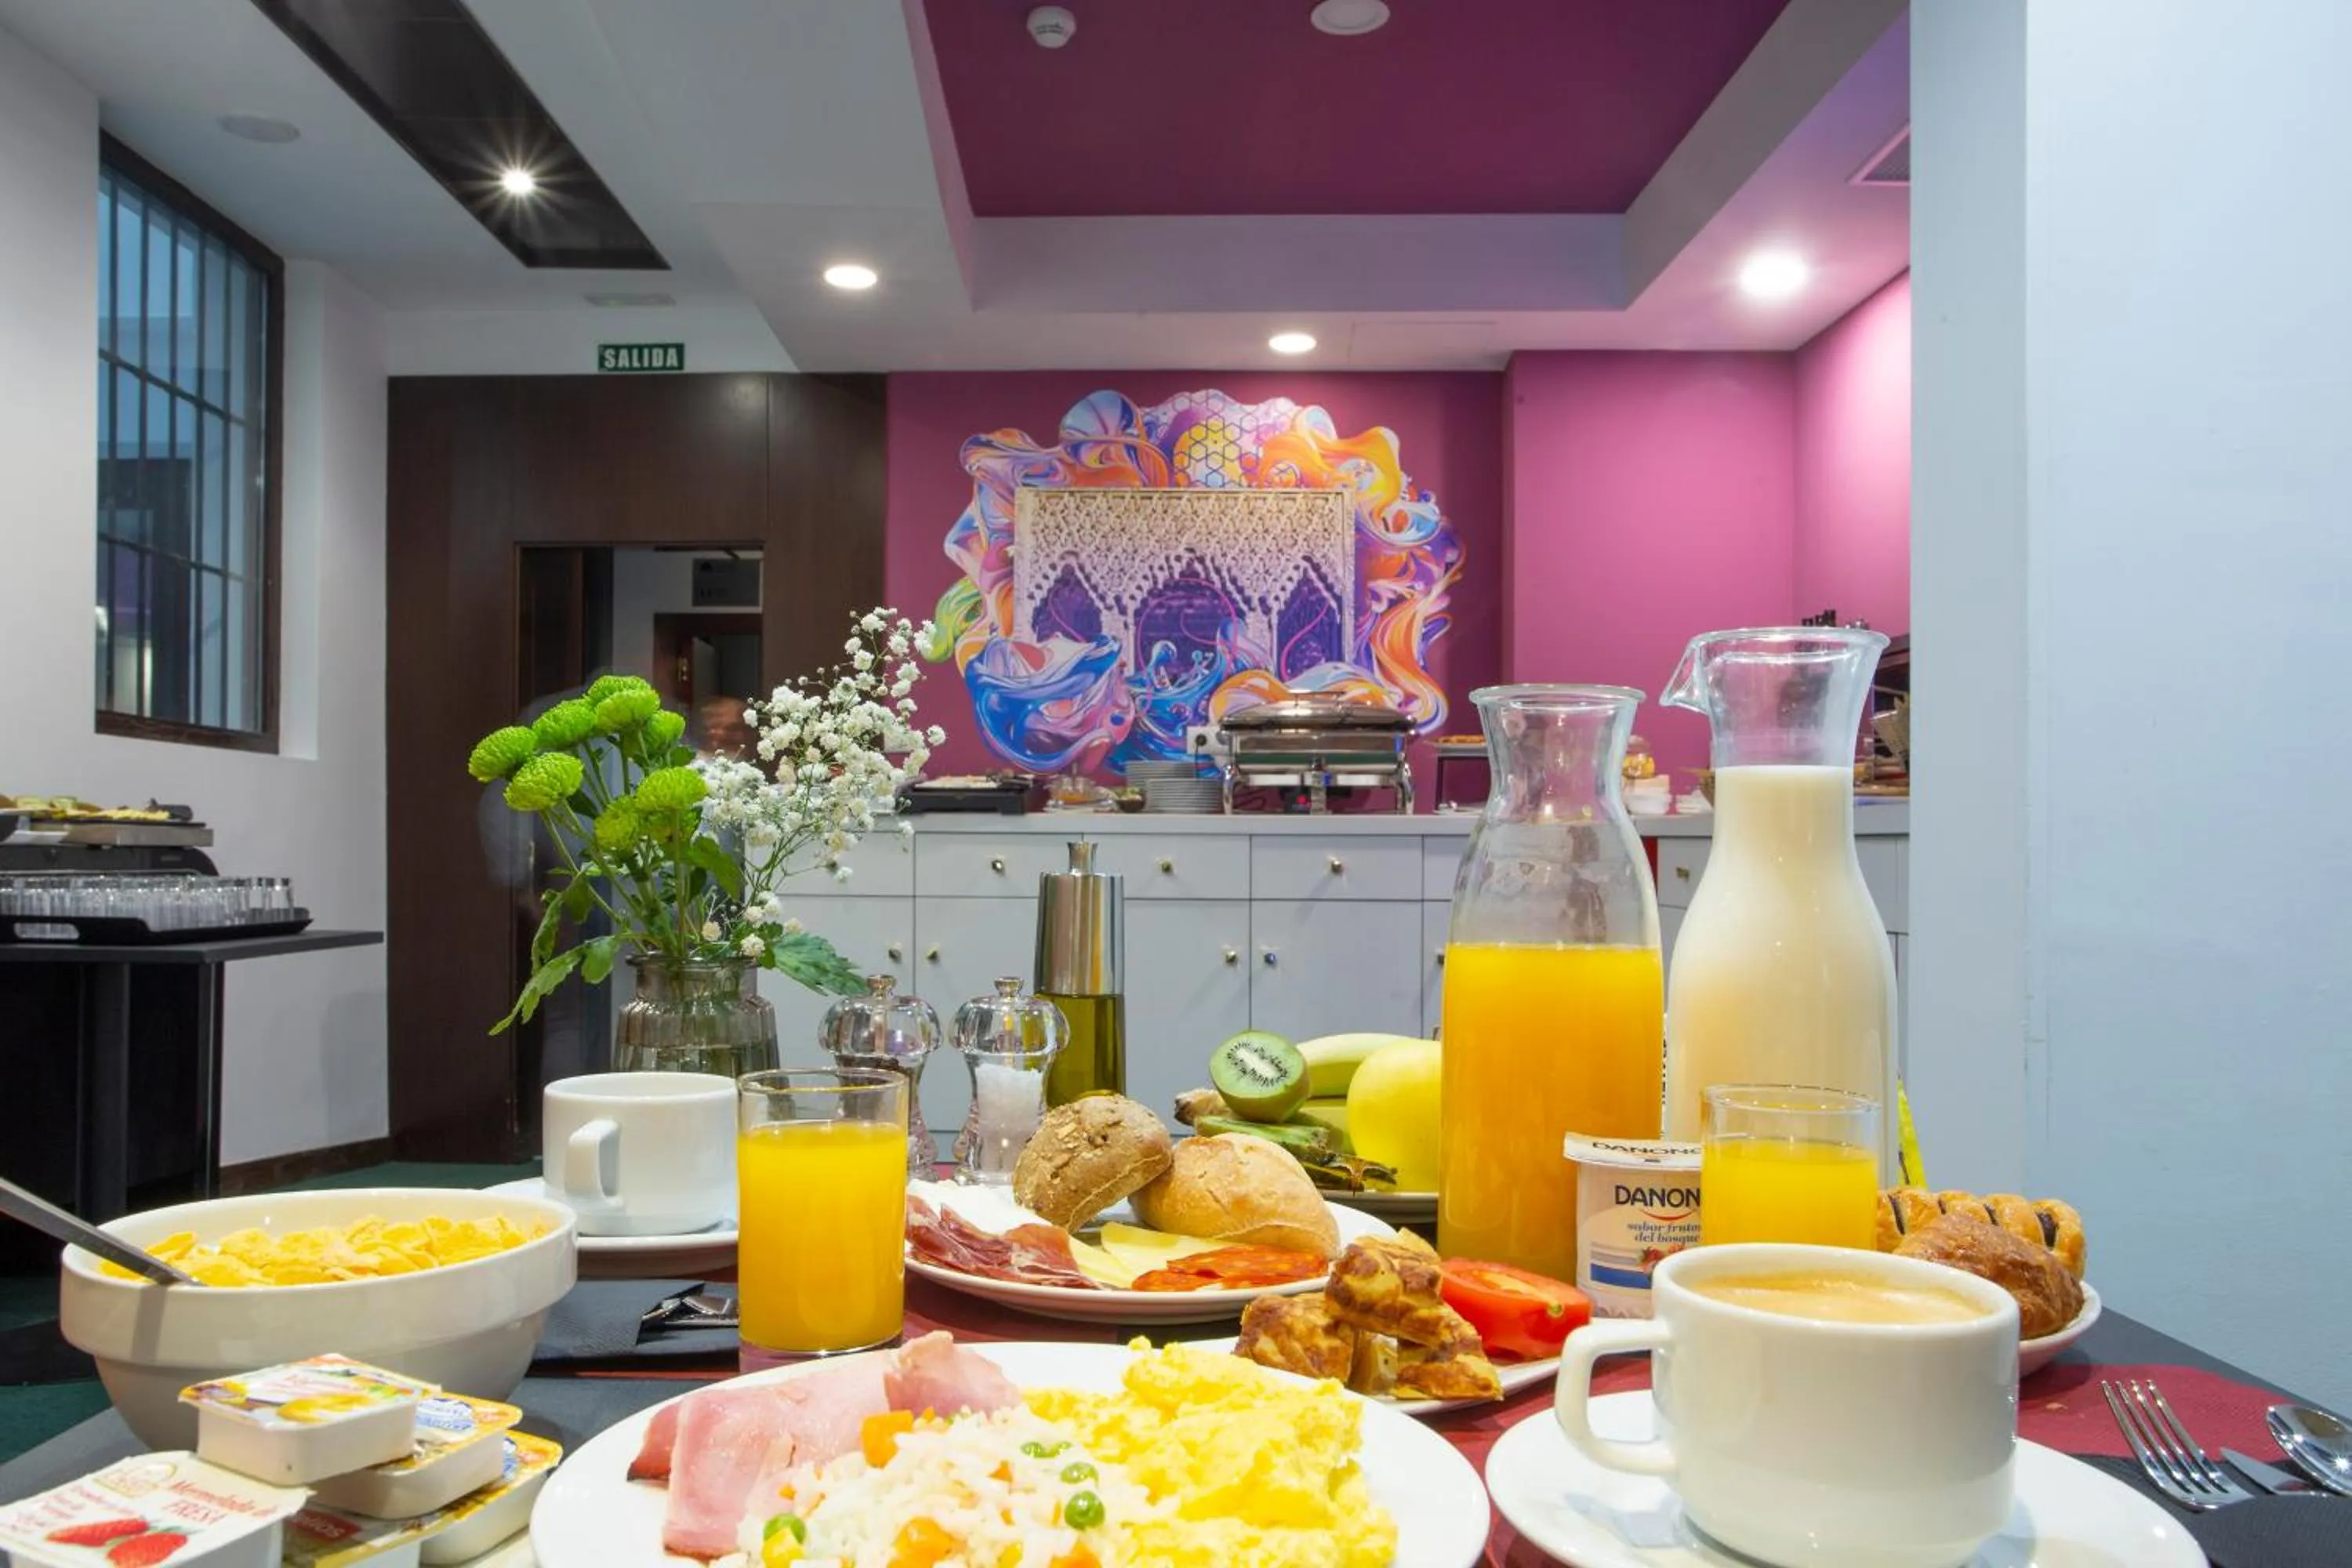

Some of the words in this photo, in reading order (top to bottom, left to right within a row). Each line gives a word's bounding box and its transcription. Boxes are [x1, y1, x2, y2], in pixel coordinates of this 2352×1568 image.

[604, 347, 678, 368] SALIDA
[1614, 1184, 1700, 1208] DANON
[1635, 1232, 1655, 1243] del
